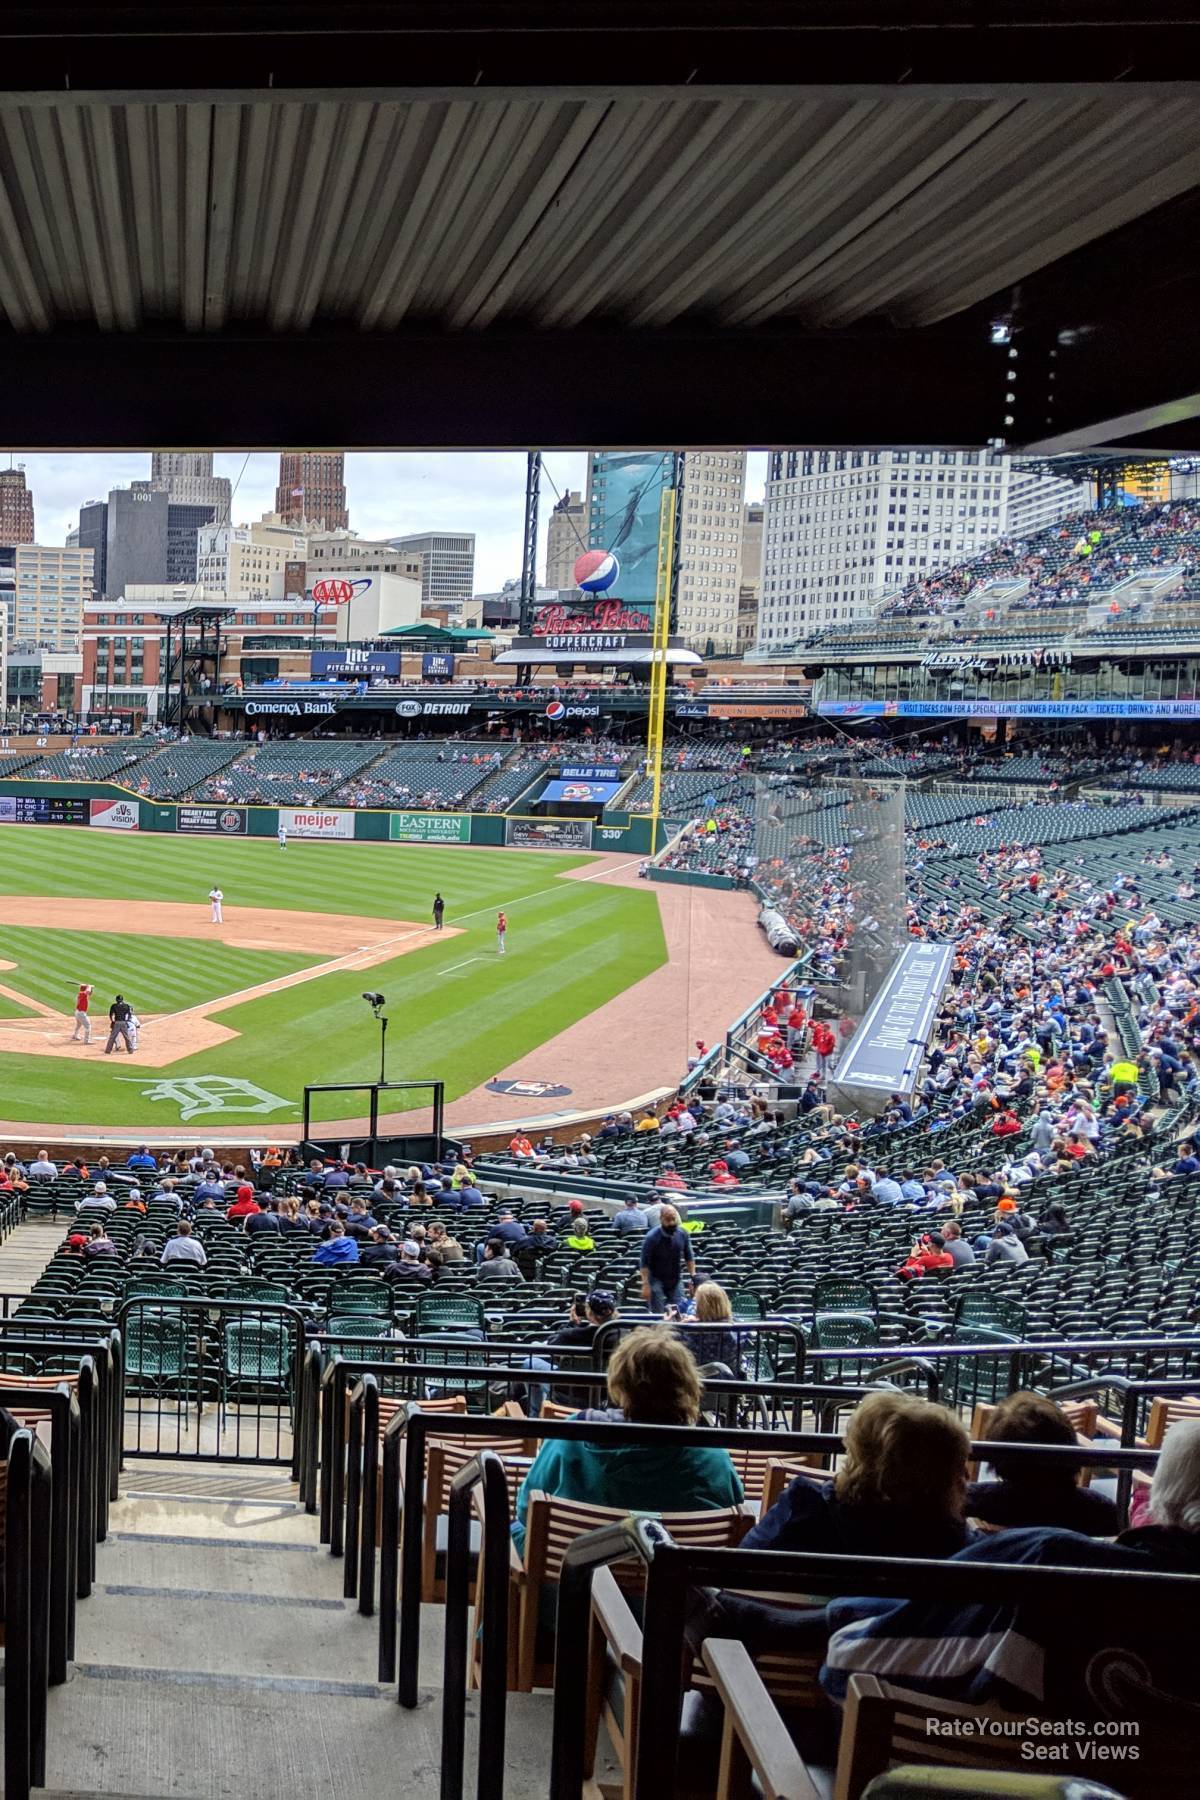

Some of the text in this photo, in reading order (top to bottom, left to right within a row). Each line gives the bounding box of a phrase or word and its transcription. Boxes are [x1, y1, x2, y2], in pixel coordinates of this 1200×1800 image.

[133, 493, 152, 502] 1001
[315, 581, 352, 605] AAA
[546, 636, 627, 648] COPPERCRAFT
[345, 649, 370, 665] Lite
[999, 652, 1072, 665] TIGER CLUB
[326, 664, 368, 672] PITCHER'S
[304, 702, 336, 714] Bank
[423, 703, 472, 714] DETROIT
[566, 705, 600, 718] pepsi
[903, 704, 918, 714] VISIT
[954, 704, 966, 714] FOR
[973, 704, 997, 714] SPECIAL
[1019, 704, 1047, 714] SUMMER
[1048, 704, 1070, 714] PARTY
[1071, 704, 1088, 714] PACK
[1128, 704, 1154, 714] DRINKS
[1156, 704, 1171, 714] AND
[1174, 704, 1196, 714] MORE!
[1, 739, 9, 747] 11
[36, 738, 47, 747] 42
[562, 769, 617, 777] BELLE TIRE
[116, 804, 132, 816] SVS
[111, 815, 136, 824] VISION
[294, 811, 339, 829] meijer
[400, 815, 461, 829] EASTERN
